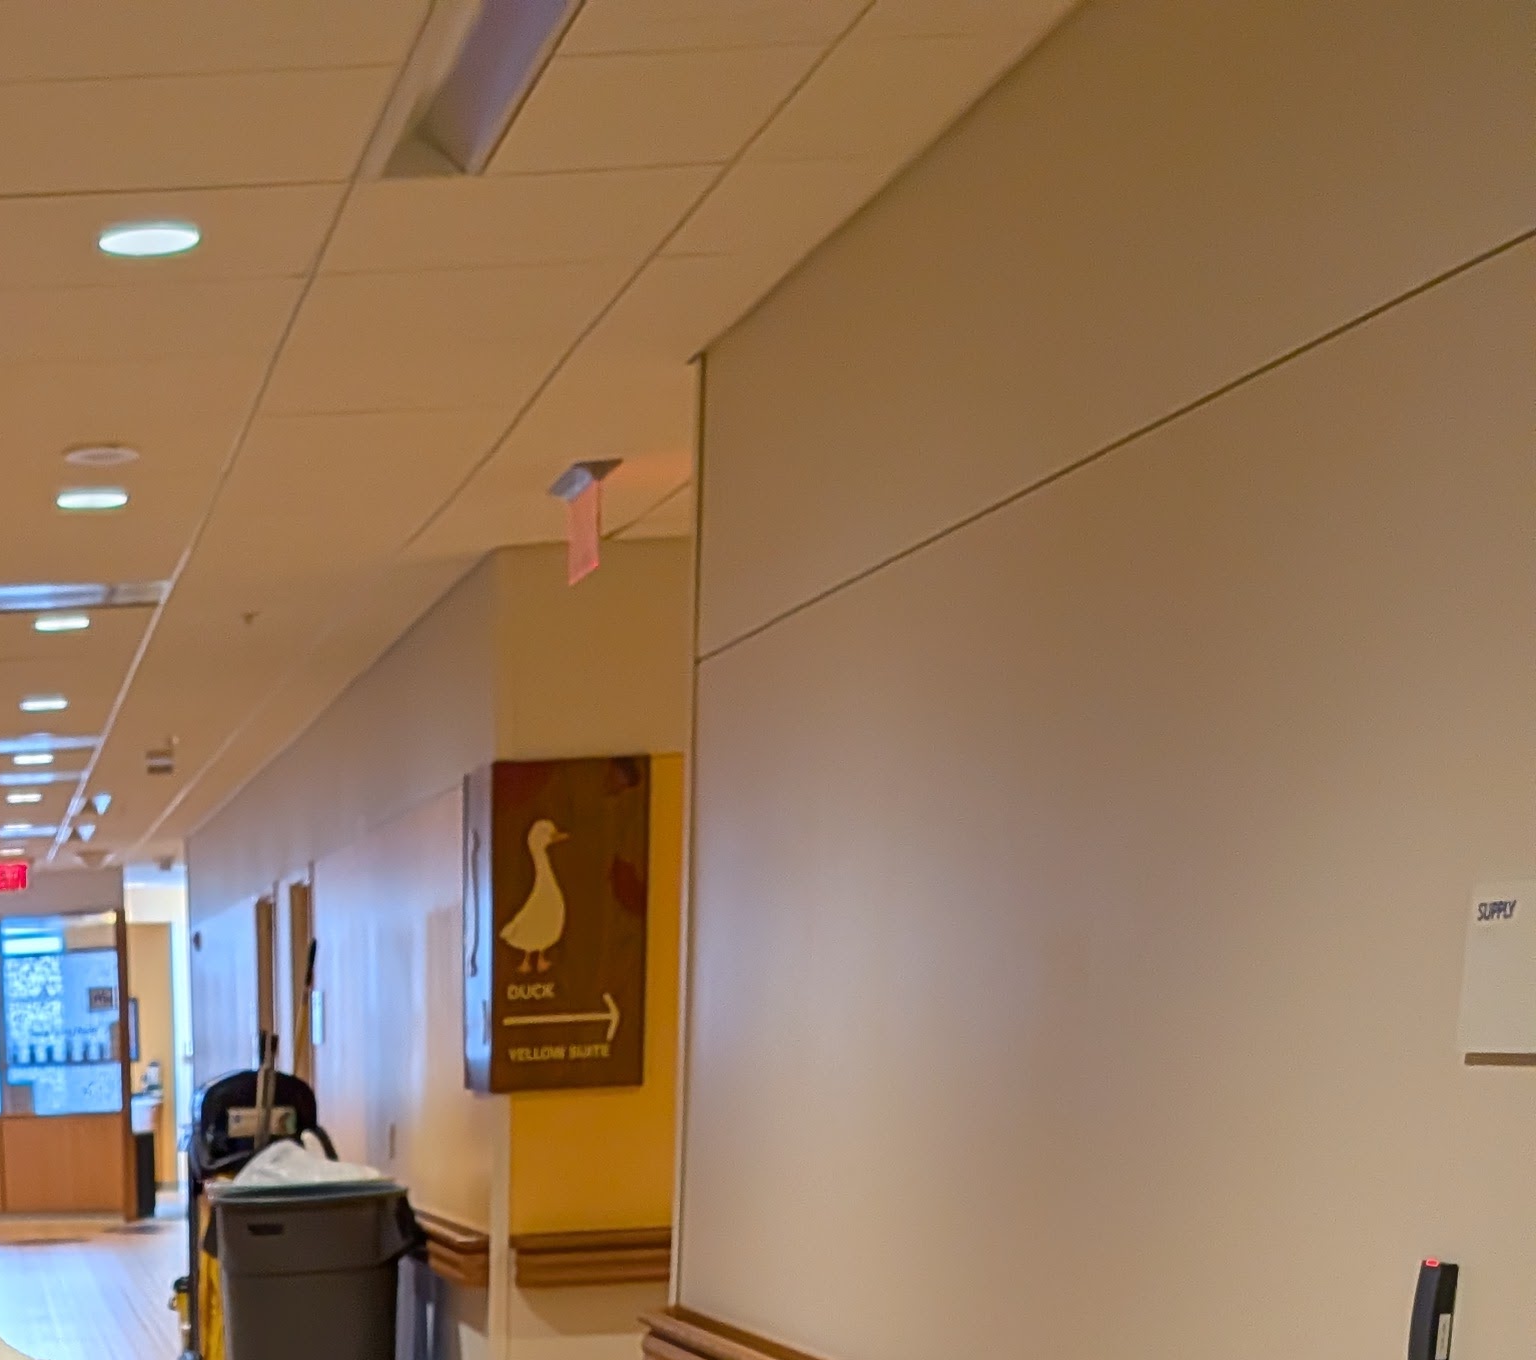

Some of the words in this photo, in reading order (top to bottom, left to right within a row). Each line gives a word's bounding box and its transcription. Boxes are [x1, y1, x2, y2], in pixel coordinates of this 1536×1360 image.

[1477, 899, 1517, 921] SUPPLY
[507, 982, 556, 1000] DUCK
[508, 1046, 566, 1061] YELLOW
